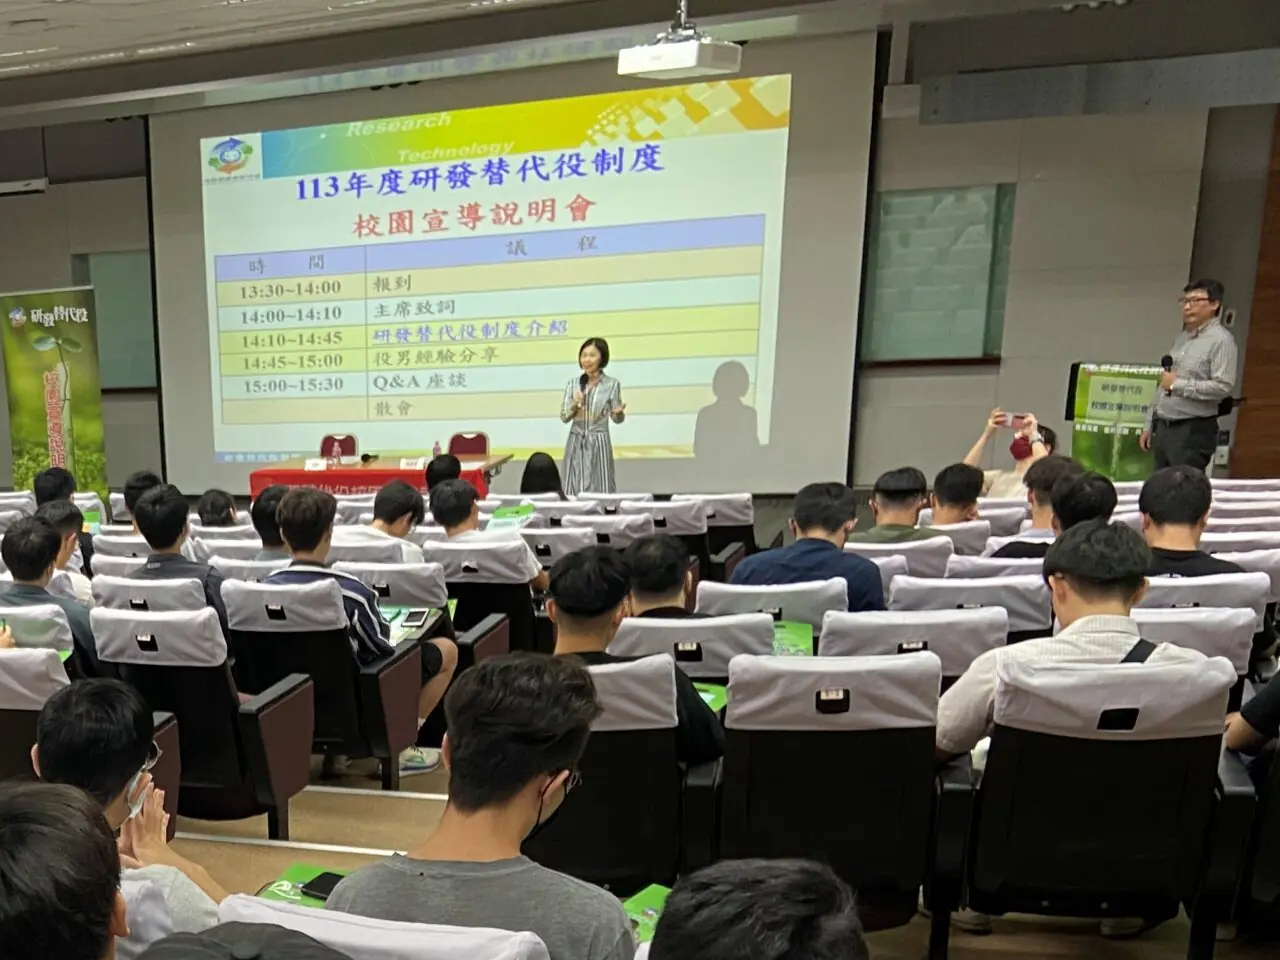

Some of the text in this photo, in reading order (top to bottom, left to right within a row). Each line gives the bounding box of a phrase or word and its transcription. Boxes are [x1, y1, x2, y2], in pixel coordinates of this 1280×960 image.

[347, 112, 452, 137] Research
[397, 141, 515, 164] Technology
[296, 144, 665, 200] 113年度研發替代役制度
[352, 193, 598, 239] 校園宣導說明會
[240, 280, 341, 299] 13:30~14:00
[372, 274, 412, 293] 報到
[241, 306, 342, 324] 14:00~14:10
[373, 300, 456, 318] 主席致詞
[242, 331, 343, 348] 14:10~14:45
[372, 319, 569, 343] 研發替代役制度介紹
[243, 354, 343, 370] 14:45~15:00
[372, 346, 499, 367] 役男經驗分享
[244, 378, 344, 393] 15:00~15:30
[373, 373, 468, 391] Q&A 座談
